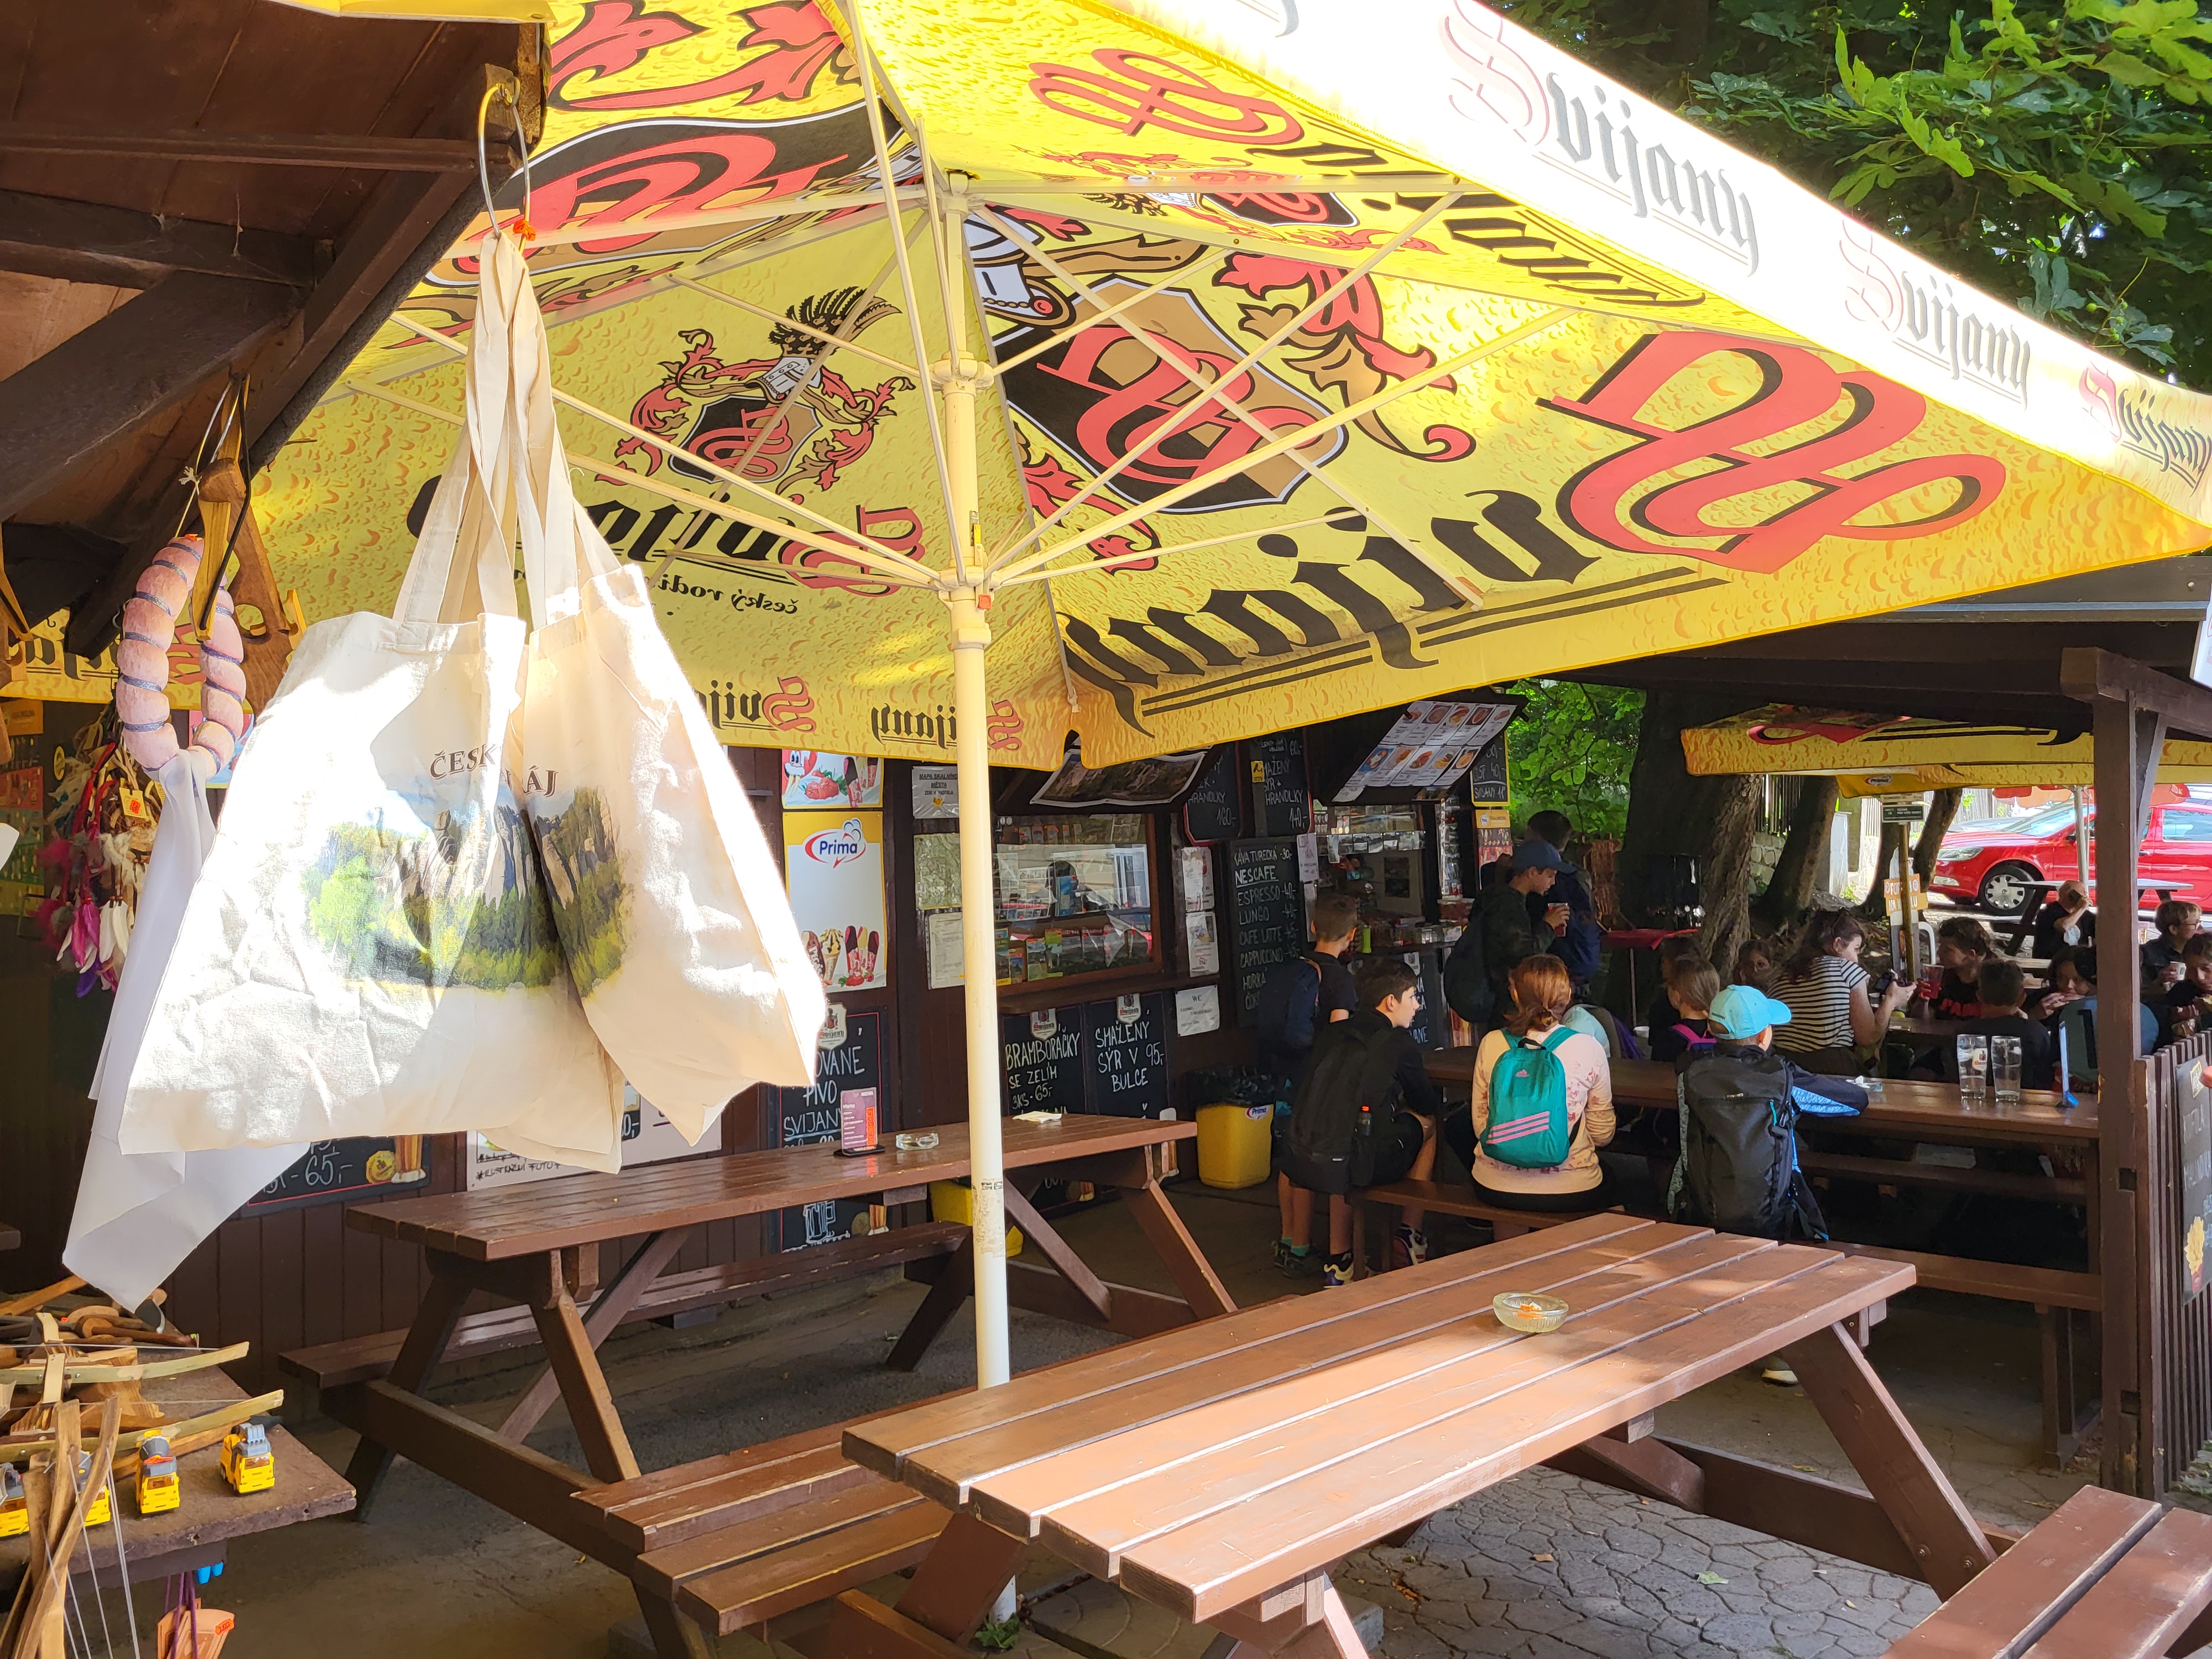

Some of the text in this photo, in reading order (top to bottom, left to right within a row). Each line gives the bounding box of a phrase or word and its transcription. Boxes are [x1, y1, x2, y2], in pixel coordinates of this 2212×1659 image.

[1839, 218, 2030, 410] Svijany
[2078, 359, 2212, 498] Svijany
[430, 743, 499, 780] ČESK
[523, 765, 559, 797] ÁJ
[820, 839, 858, 855] Prima
[1238, 885, 1281, 906] ESPRESSO
[1239, 905, 1270, 925] LUNGO
[1004, 1024, 1081, 1071] BRAMBORÁČKY
[1128, 1047, 1138, 1065] V
[1009, 1061, 1057, 1089] SE ZELÍM
[1110, 1067, 1149, 1093] BULCE
